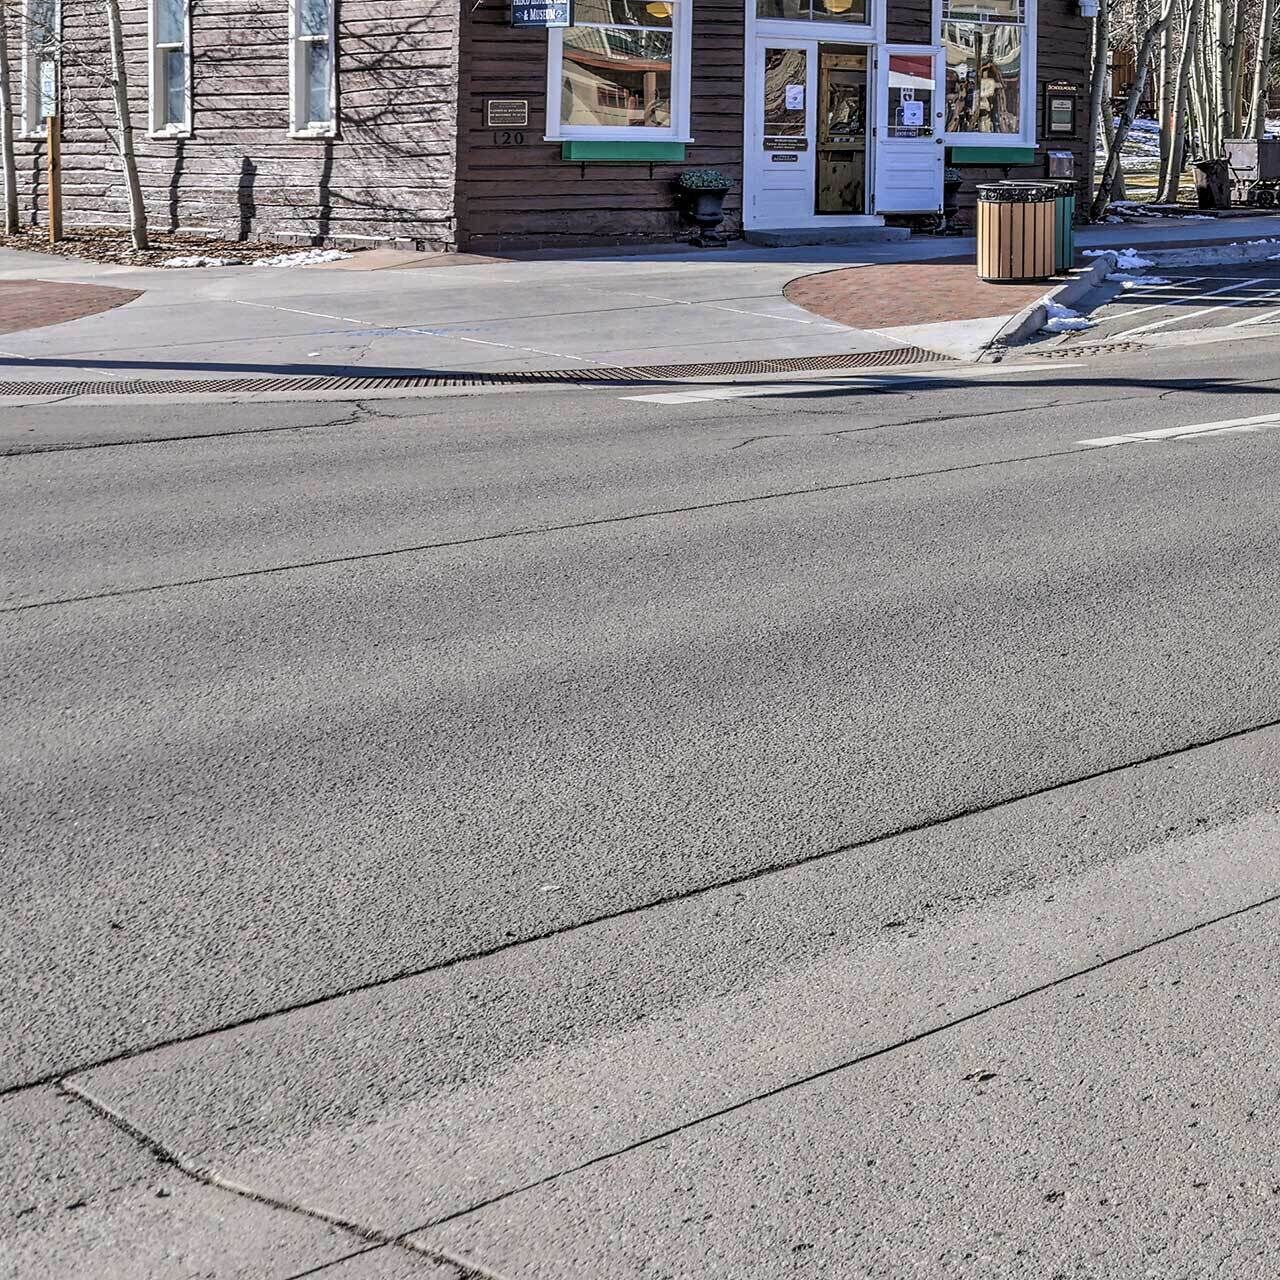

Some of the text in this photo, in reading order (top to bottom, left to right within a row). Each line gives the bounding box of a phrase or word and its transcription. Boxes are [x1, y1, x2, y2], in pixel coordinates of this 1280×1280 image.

[523, 9, 556, 20] & MUSEUM
[494, 132, 523, 144] 120
